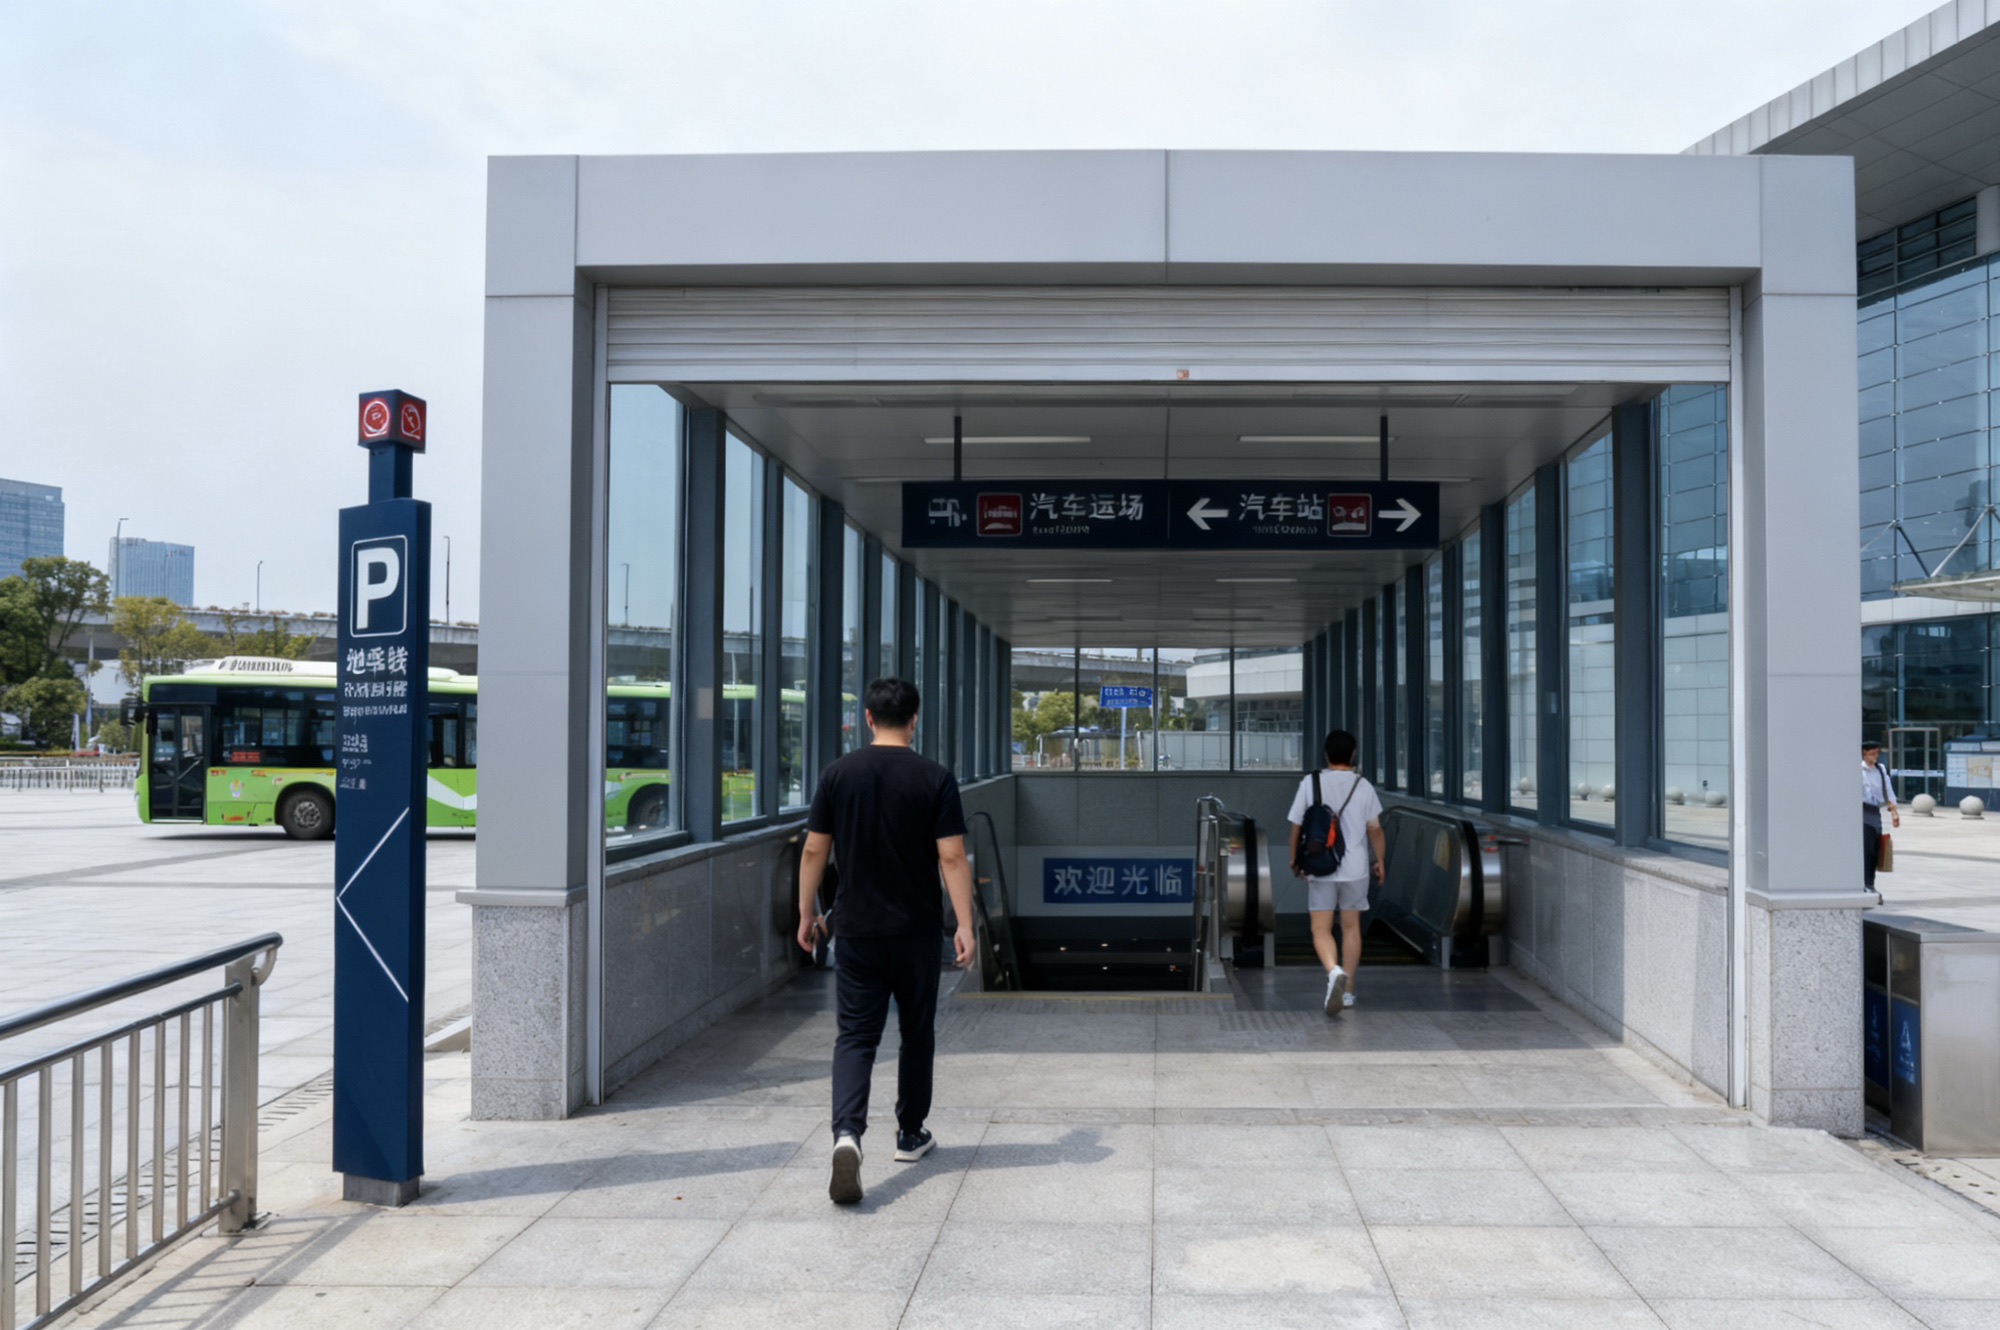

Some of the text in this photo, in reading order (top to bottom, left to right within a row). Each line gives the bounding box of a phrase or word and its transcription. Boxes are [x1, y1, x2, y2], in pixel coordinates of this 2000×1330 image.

[1238, 492, 1325, 521] 汽车站
[356, 546, 400, 630] P
[1053, 863, 1183, 896] 欢迎光临
